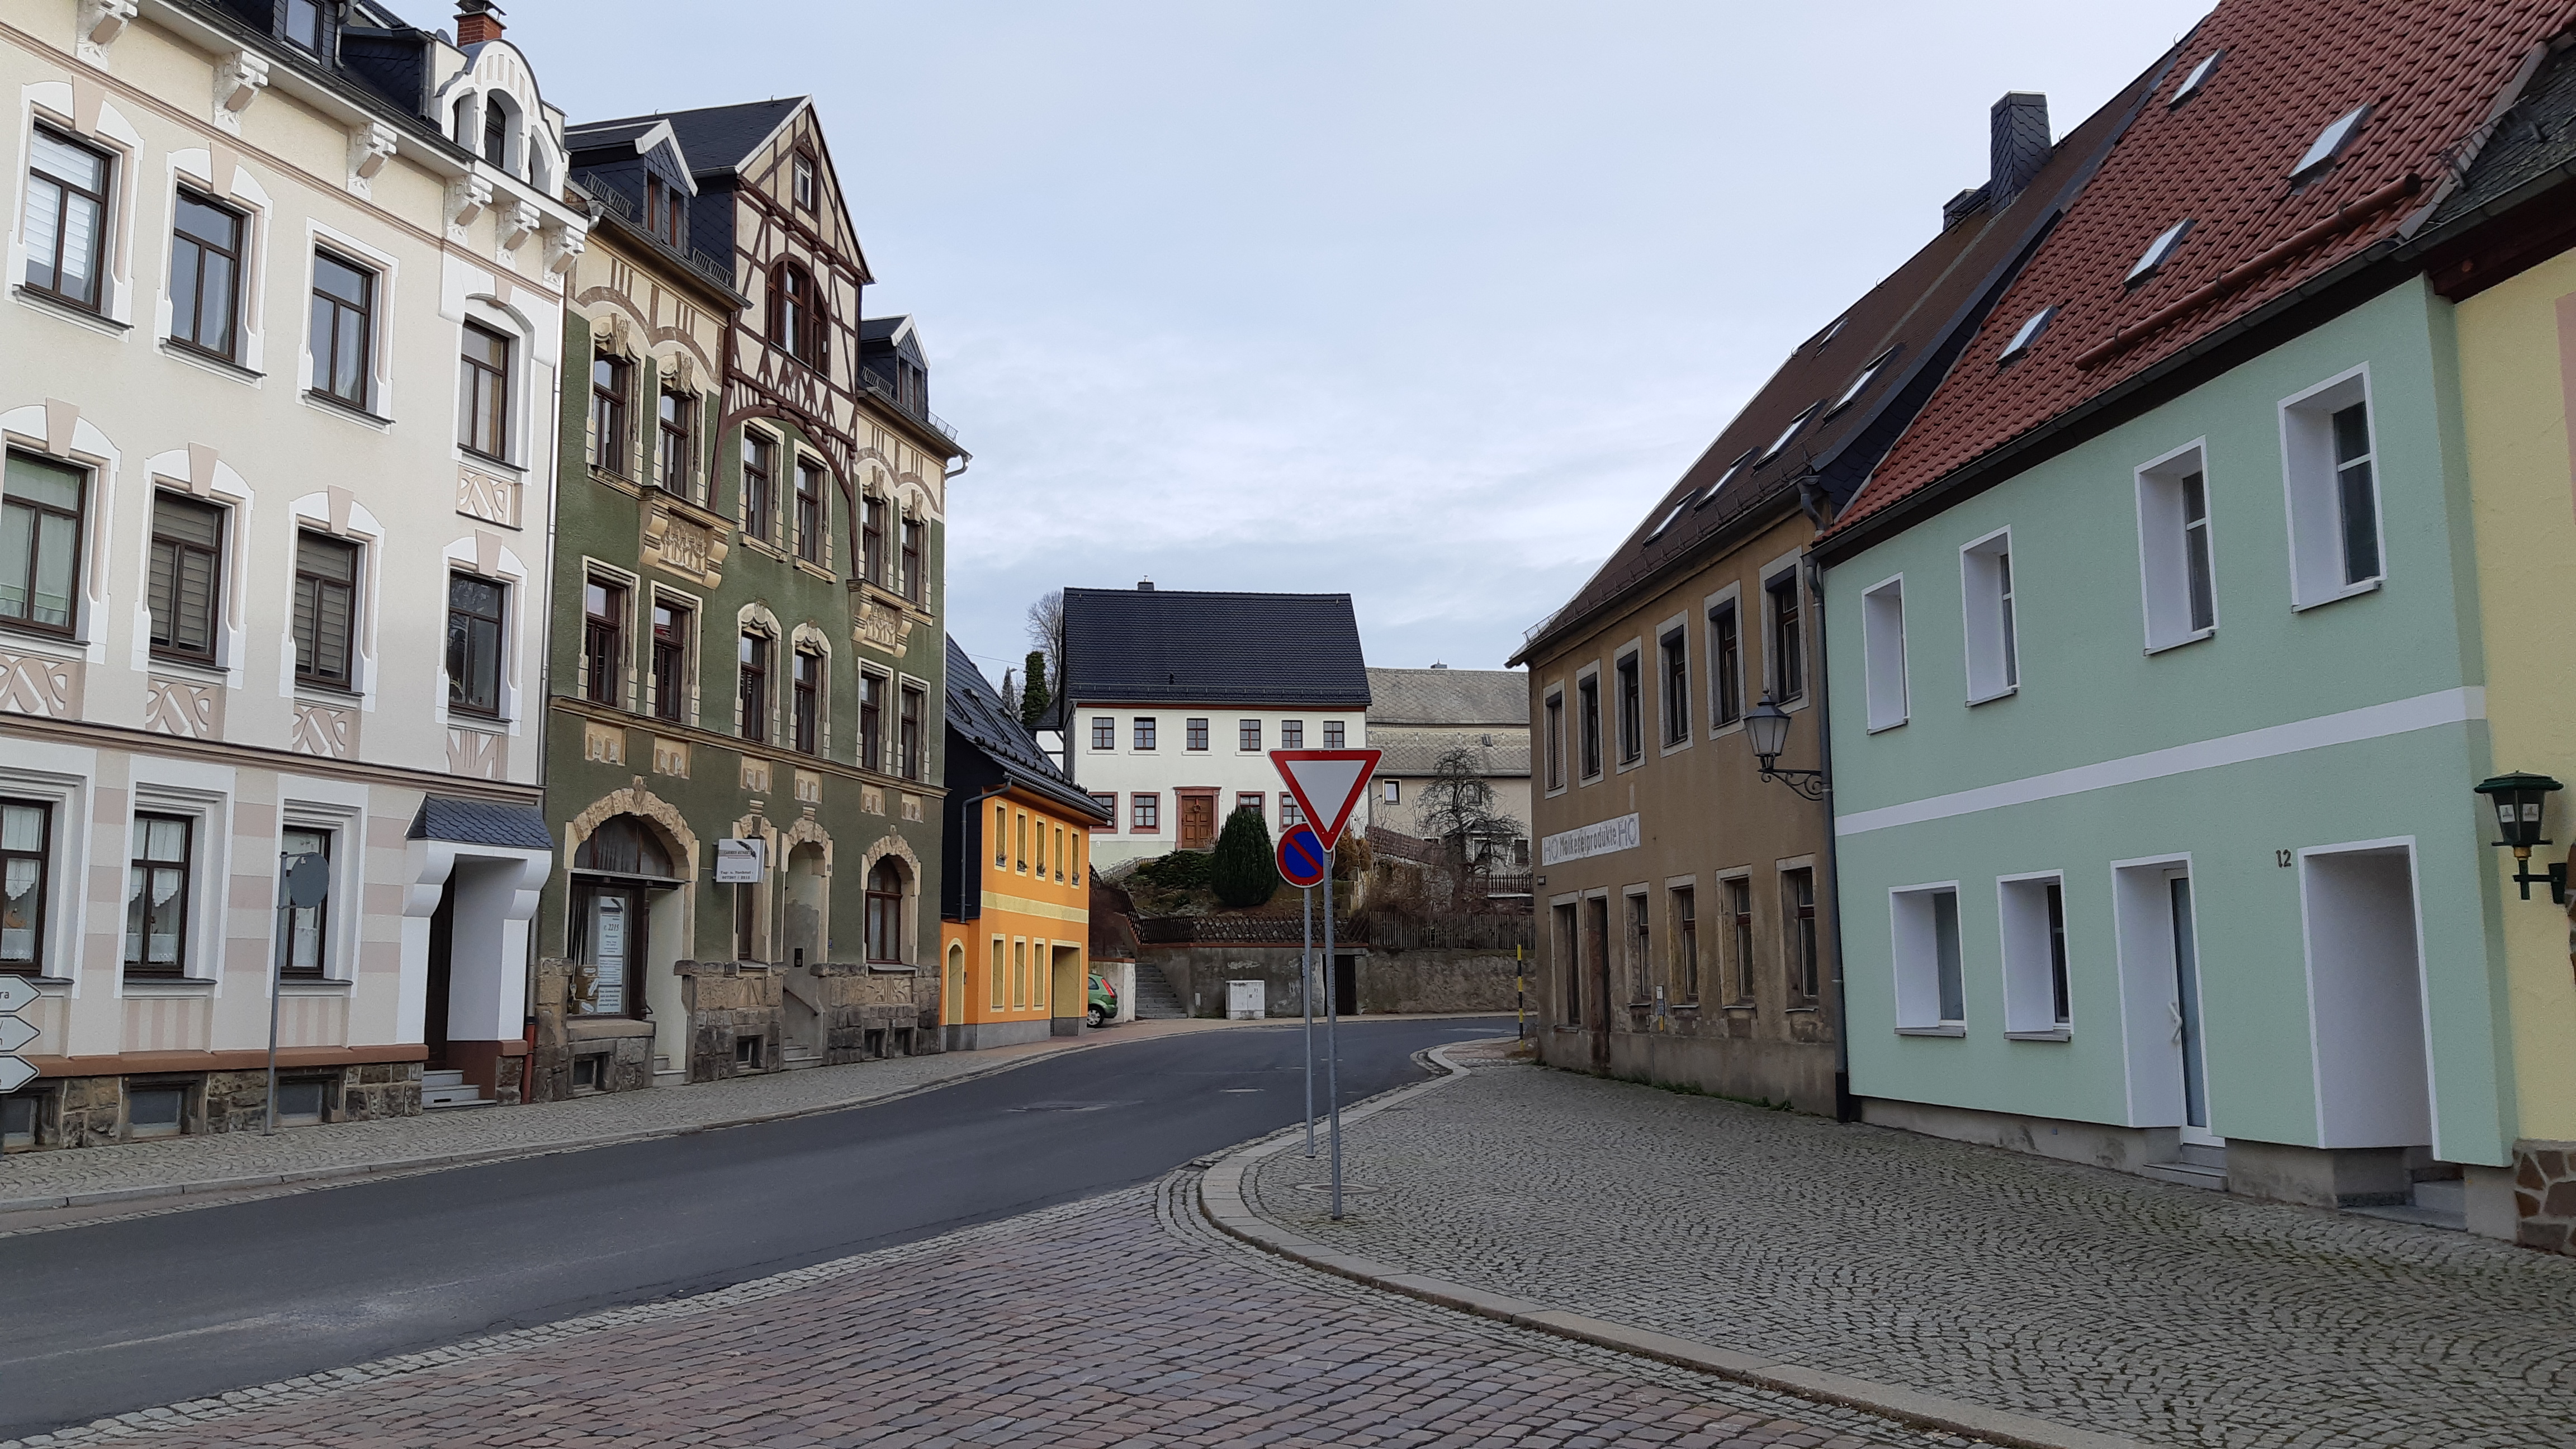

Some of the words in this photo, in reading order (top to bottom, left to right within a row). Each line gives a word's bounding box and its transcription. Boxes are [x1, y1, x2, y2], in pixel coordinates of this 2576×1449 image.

[1543, 839, 1559, 863] HO
[1618, 817, 1637, 847] HO
[2275, 849, 2291, 868] 12
